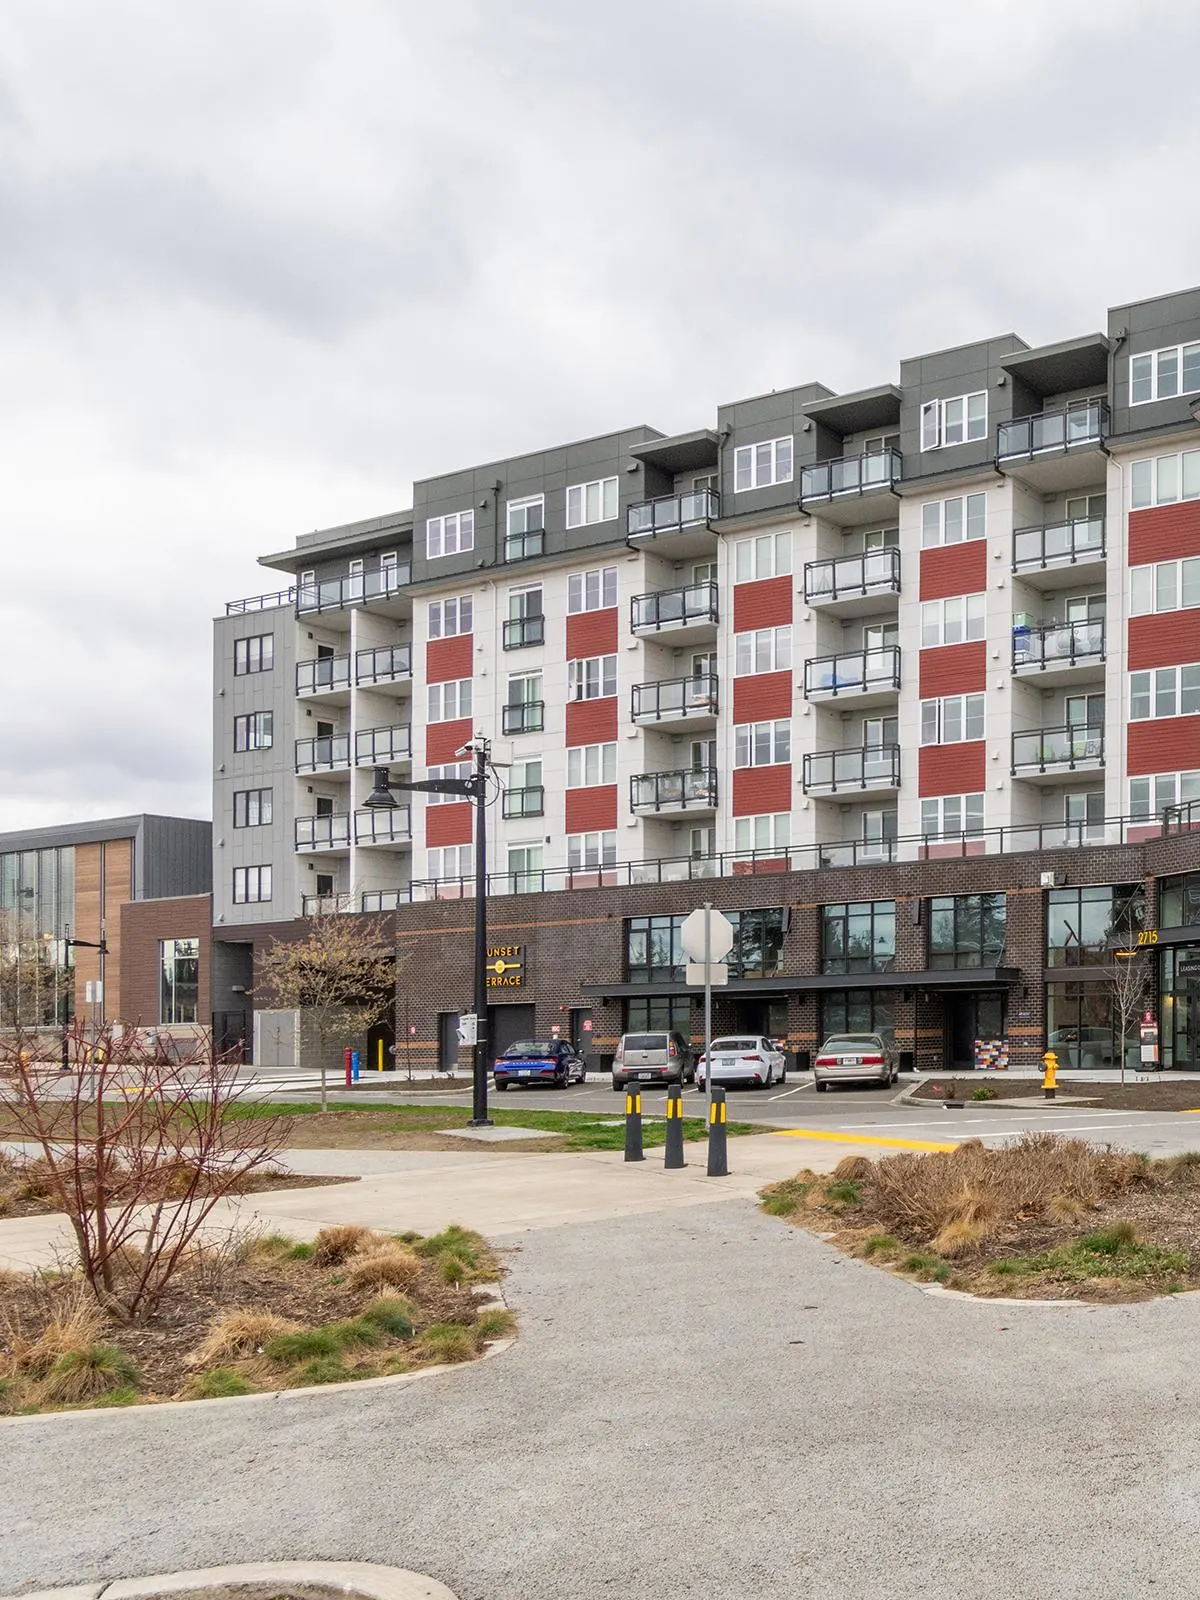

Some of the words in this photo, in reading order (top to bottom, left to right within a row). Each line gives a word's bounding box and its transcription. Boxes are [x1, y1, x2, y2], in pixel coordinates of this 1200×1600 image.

[1138, 930, 1158, 944] 2715
[486, 946, 520, 957] UNSET
[486, 975, 521, 987] ERRACE
